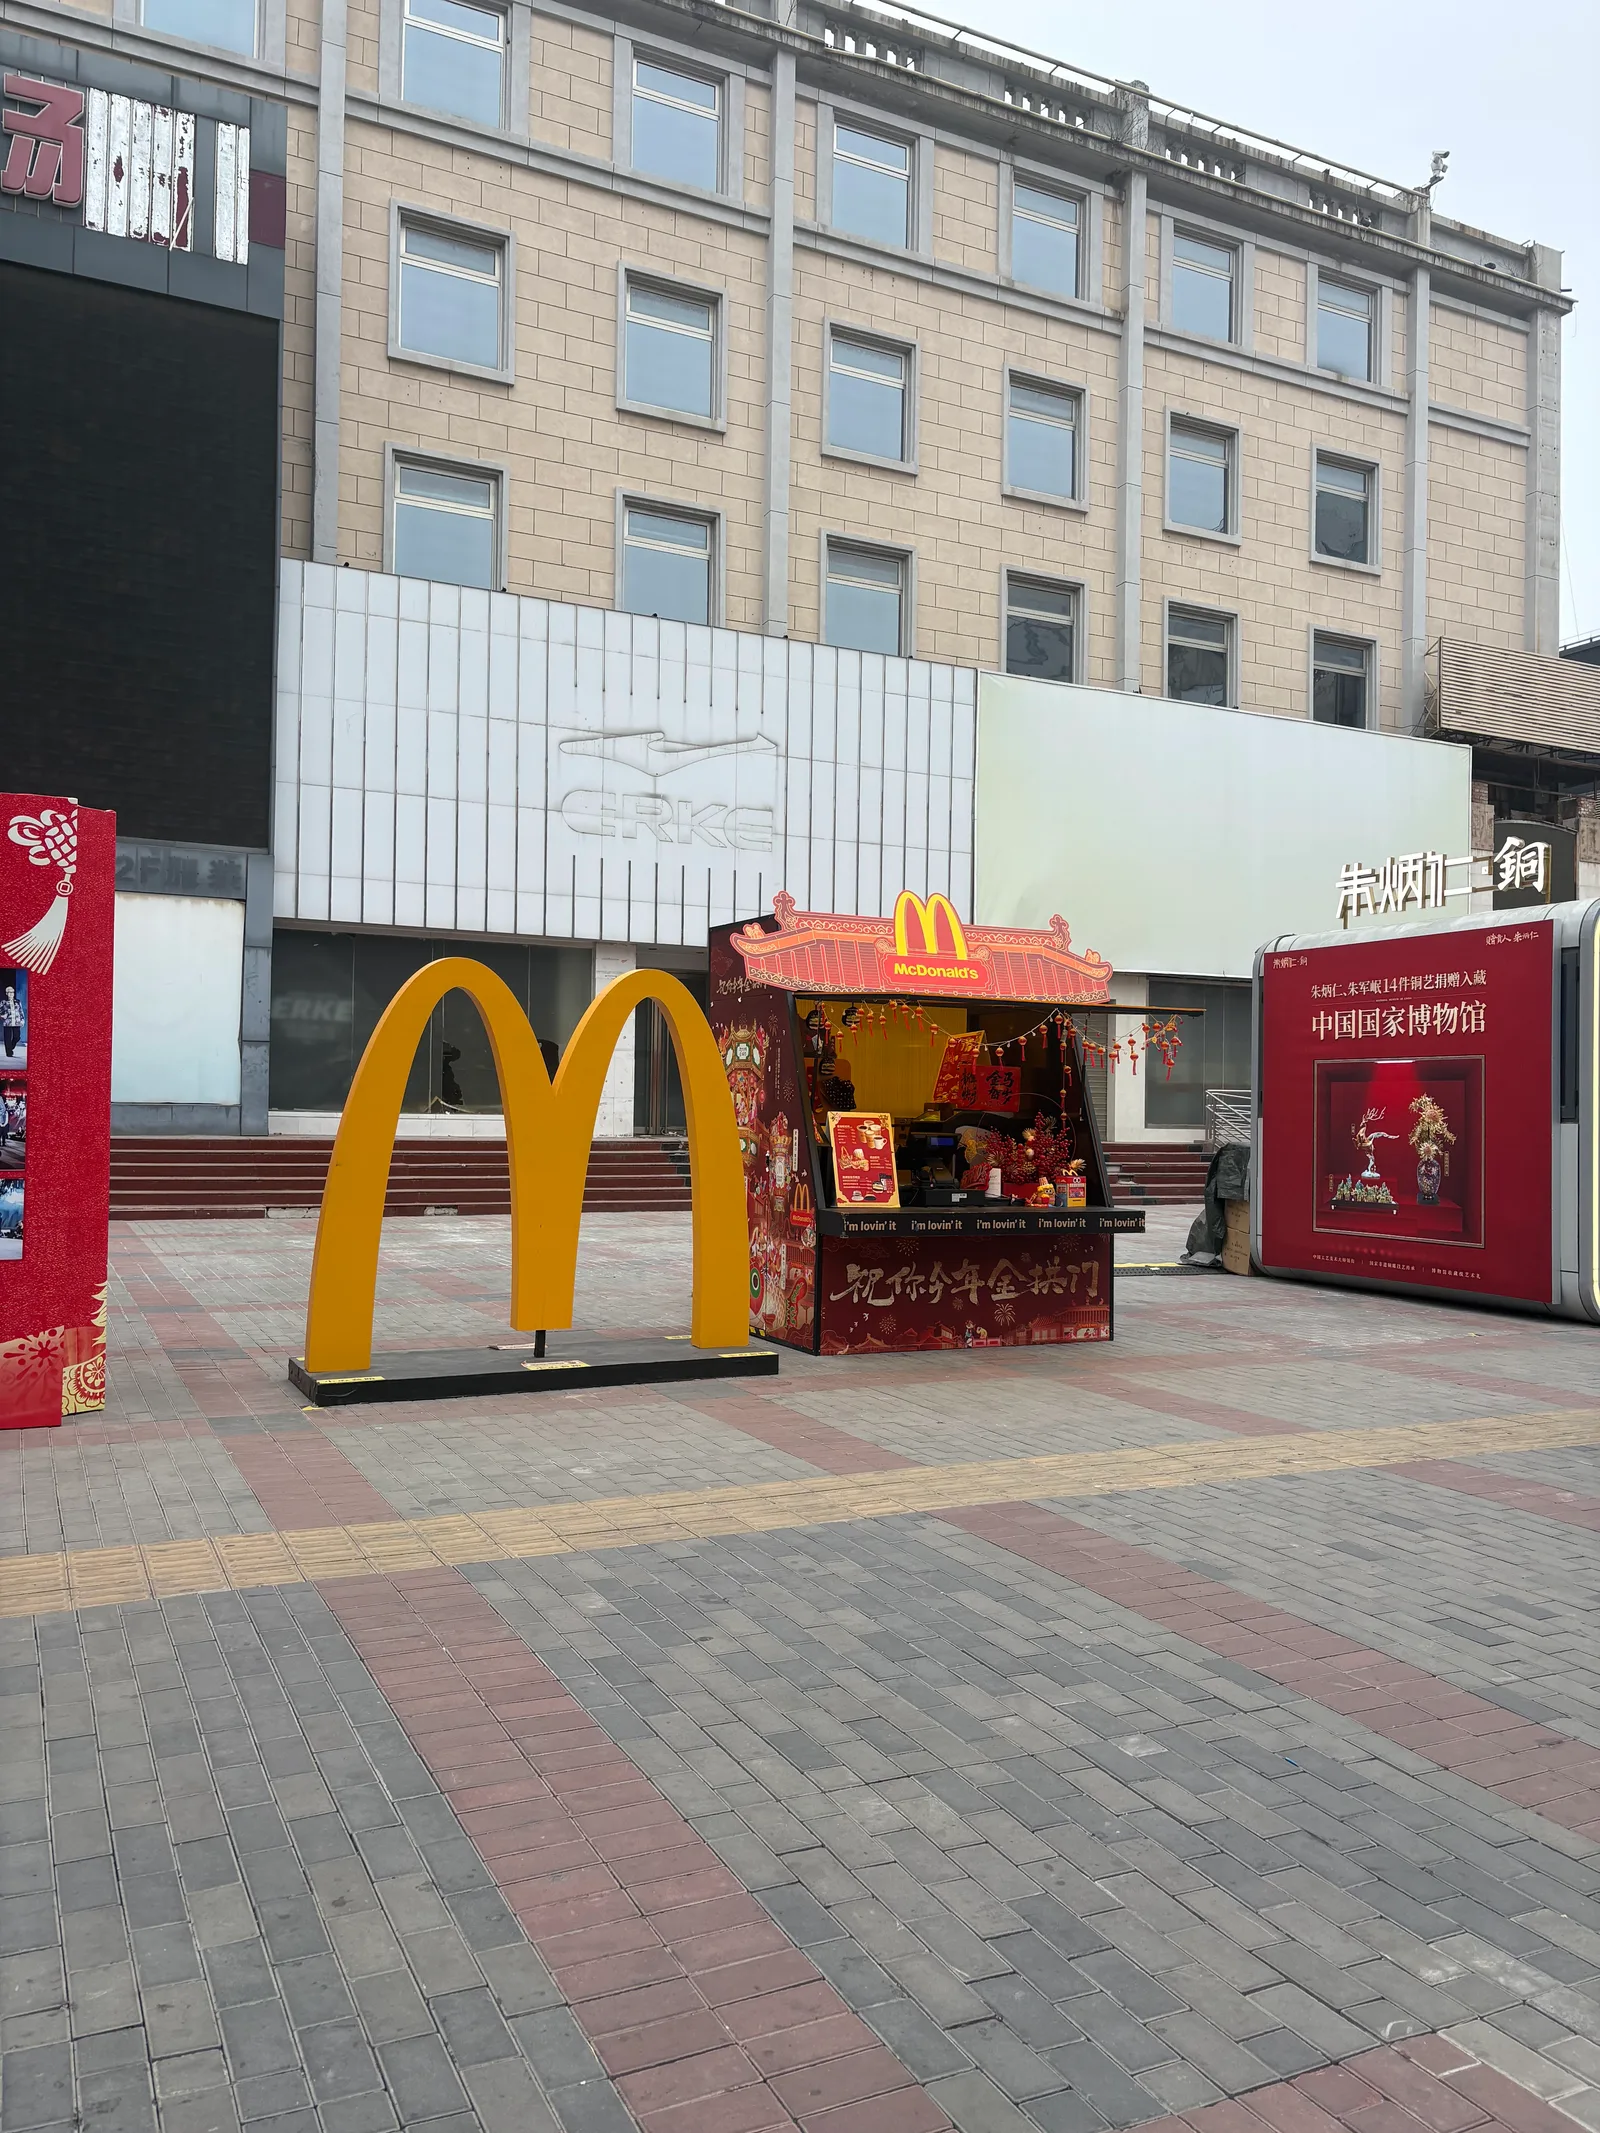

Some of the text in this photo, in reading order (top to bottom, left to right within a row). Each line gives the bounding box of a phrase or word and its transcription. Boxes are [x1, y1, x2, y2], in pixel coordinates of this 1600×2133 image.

[561, 789, 773, 852] ERKE
[894, 962, 979, 980] McDonald's
[1311, 1000, 1487, 1041] 中国国家博物馆
[860, 1220, 887, 1231] lovin'
[888, 1220, 897, 1230] it
[928, 1219, 954, 1230] lovin'
[955, 1220, 962, 1230] it
[992, 1219, 1017, 1229] lovin'
[1018, 1219, 1026, 1229] it
[1054, 1218, 1078, 1228] lovin'
[1079, 1218, 1086, 1227] it
[1114, 1218, 1137, 1227] lovin'
[829, 1256, 1100, 1306] 祝你今年金拱门
